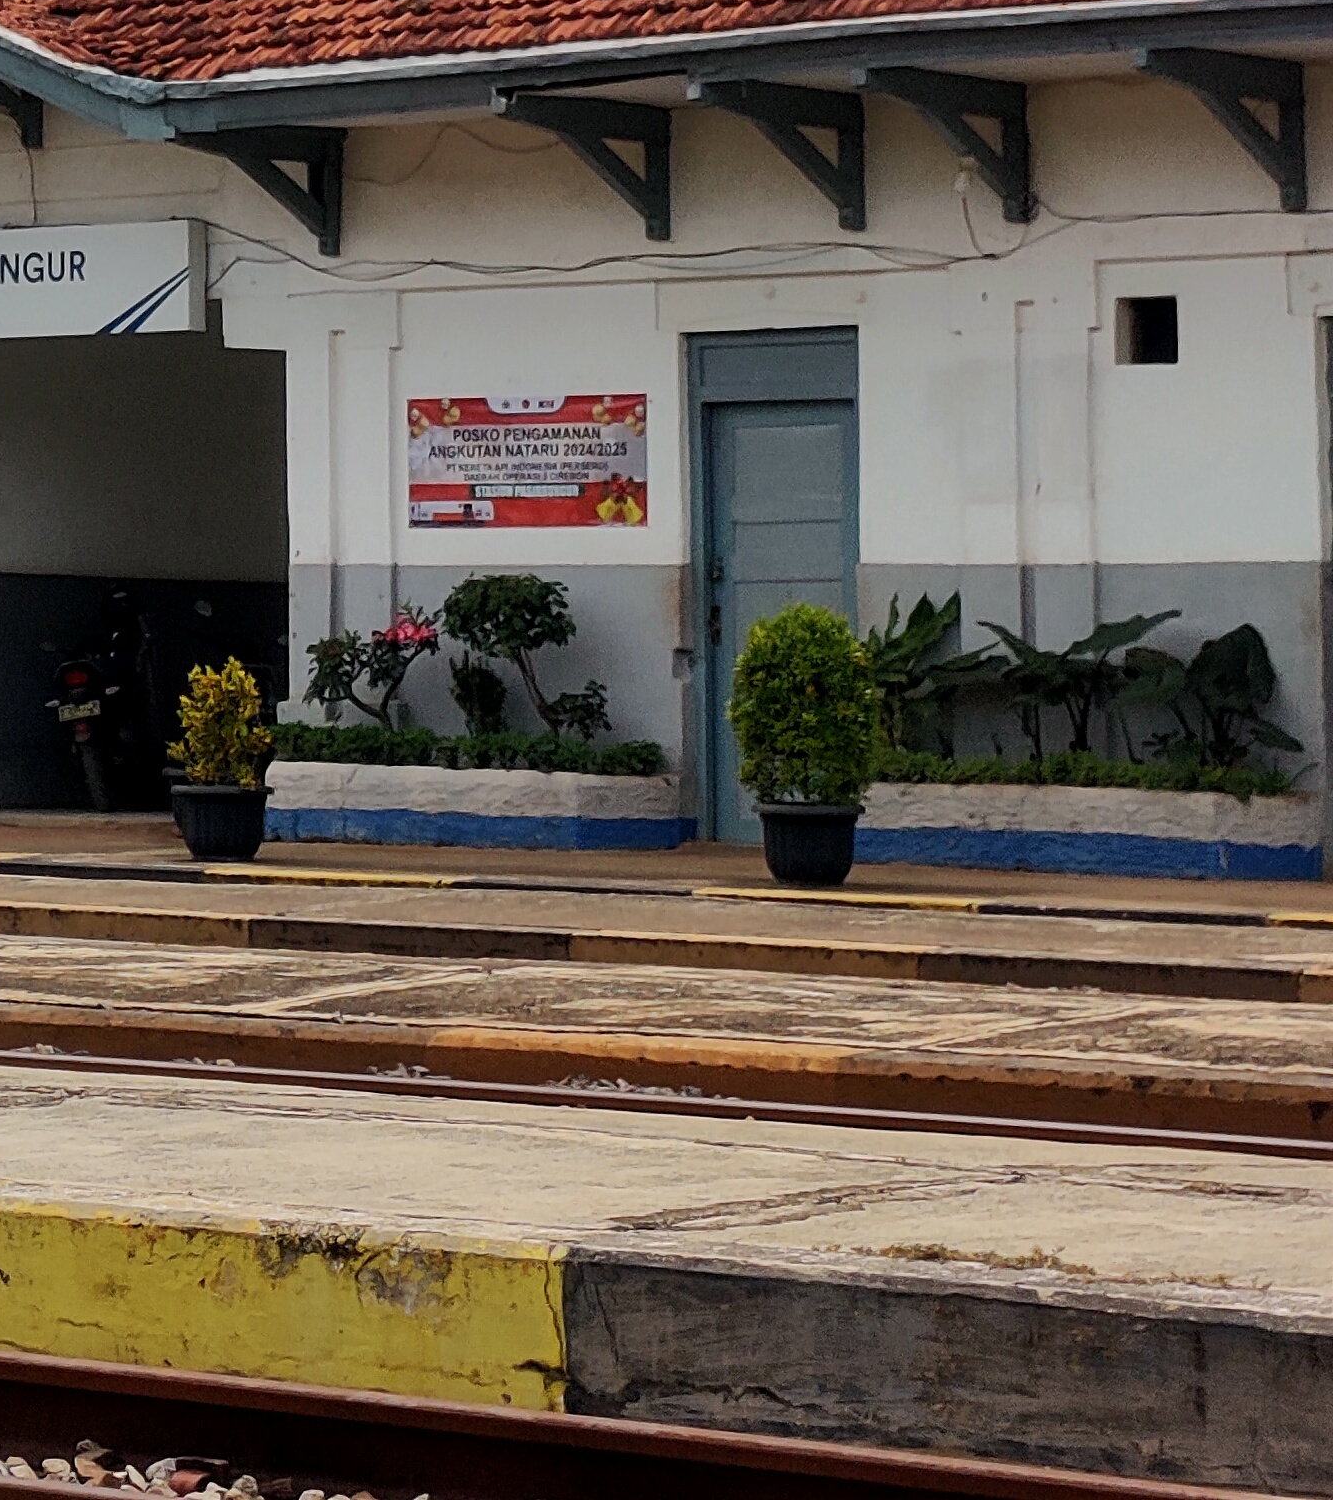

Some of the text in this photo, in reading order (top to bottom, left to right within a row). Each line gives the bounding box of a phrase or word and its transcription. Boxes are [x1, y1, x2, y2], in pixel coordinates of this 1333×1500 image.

[453, 426, 601, 442] POSKO PENGAMANAN
[428, 442, 628, 459] ANGKUTAN NATARU 2024/2025
